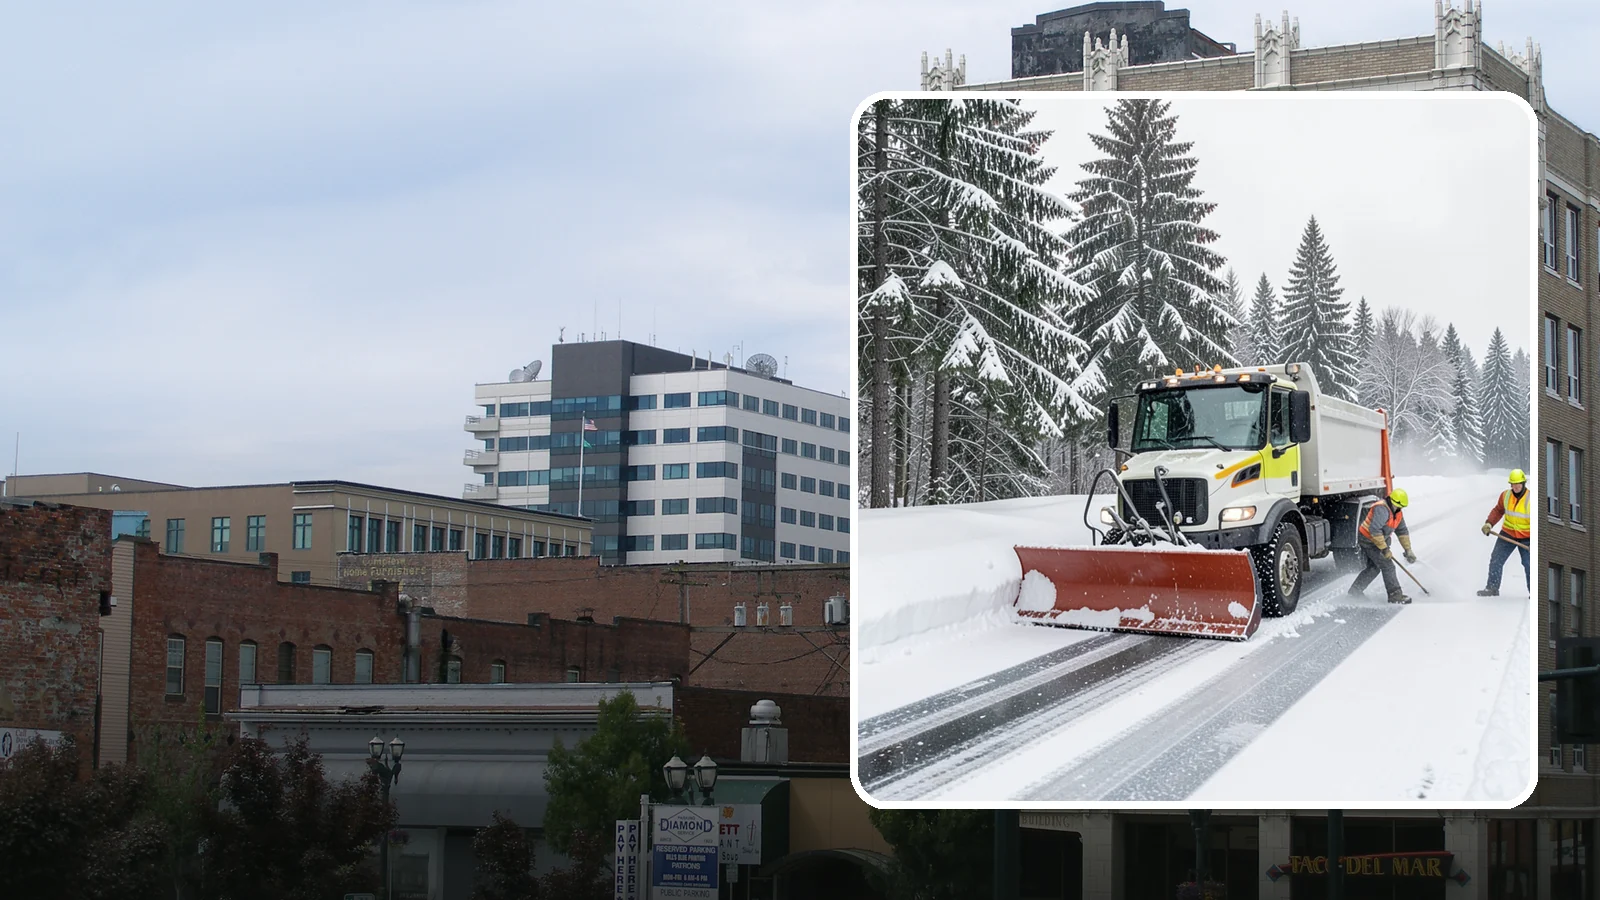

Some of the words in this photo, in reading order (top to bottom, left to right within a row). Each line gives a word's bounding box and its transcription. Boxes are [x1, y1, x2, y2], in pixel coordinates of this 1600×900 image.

[370, 566, 427, 576] Furnishers
[660, 818, 713, 832] DIAMOND
[1021, 815, 1070, 827] BUILDING
[617, 825, 625, 852] PAY
[629, 824, 637, 852] PAY
[656, 845, 688, 853] RESERVED
[689, 846, 716, 854] PARKING
[721, 851, 739, 863] Soup
[671, 862, 701, 870] PATRONS
[1289, 855, 1330, 874] TAC
[1345, 855, 1384, 876] DEL
[1392, 857, 1442, 877] MAR
[616, 856, 625, 893] HERE
[628, 855, 636, 893] HERE
[660, 888, 682, 897] PUBLIC
[683, 889, 710, 898] PARKING
